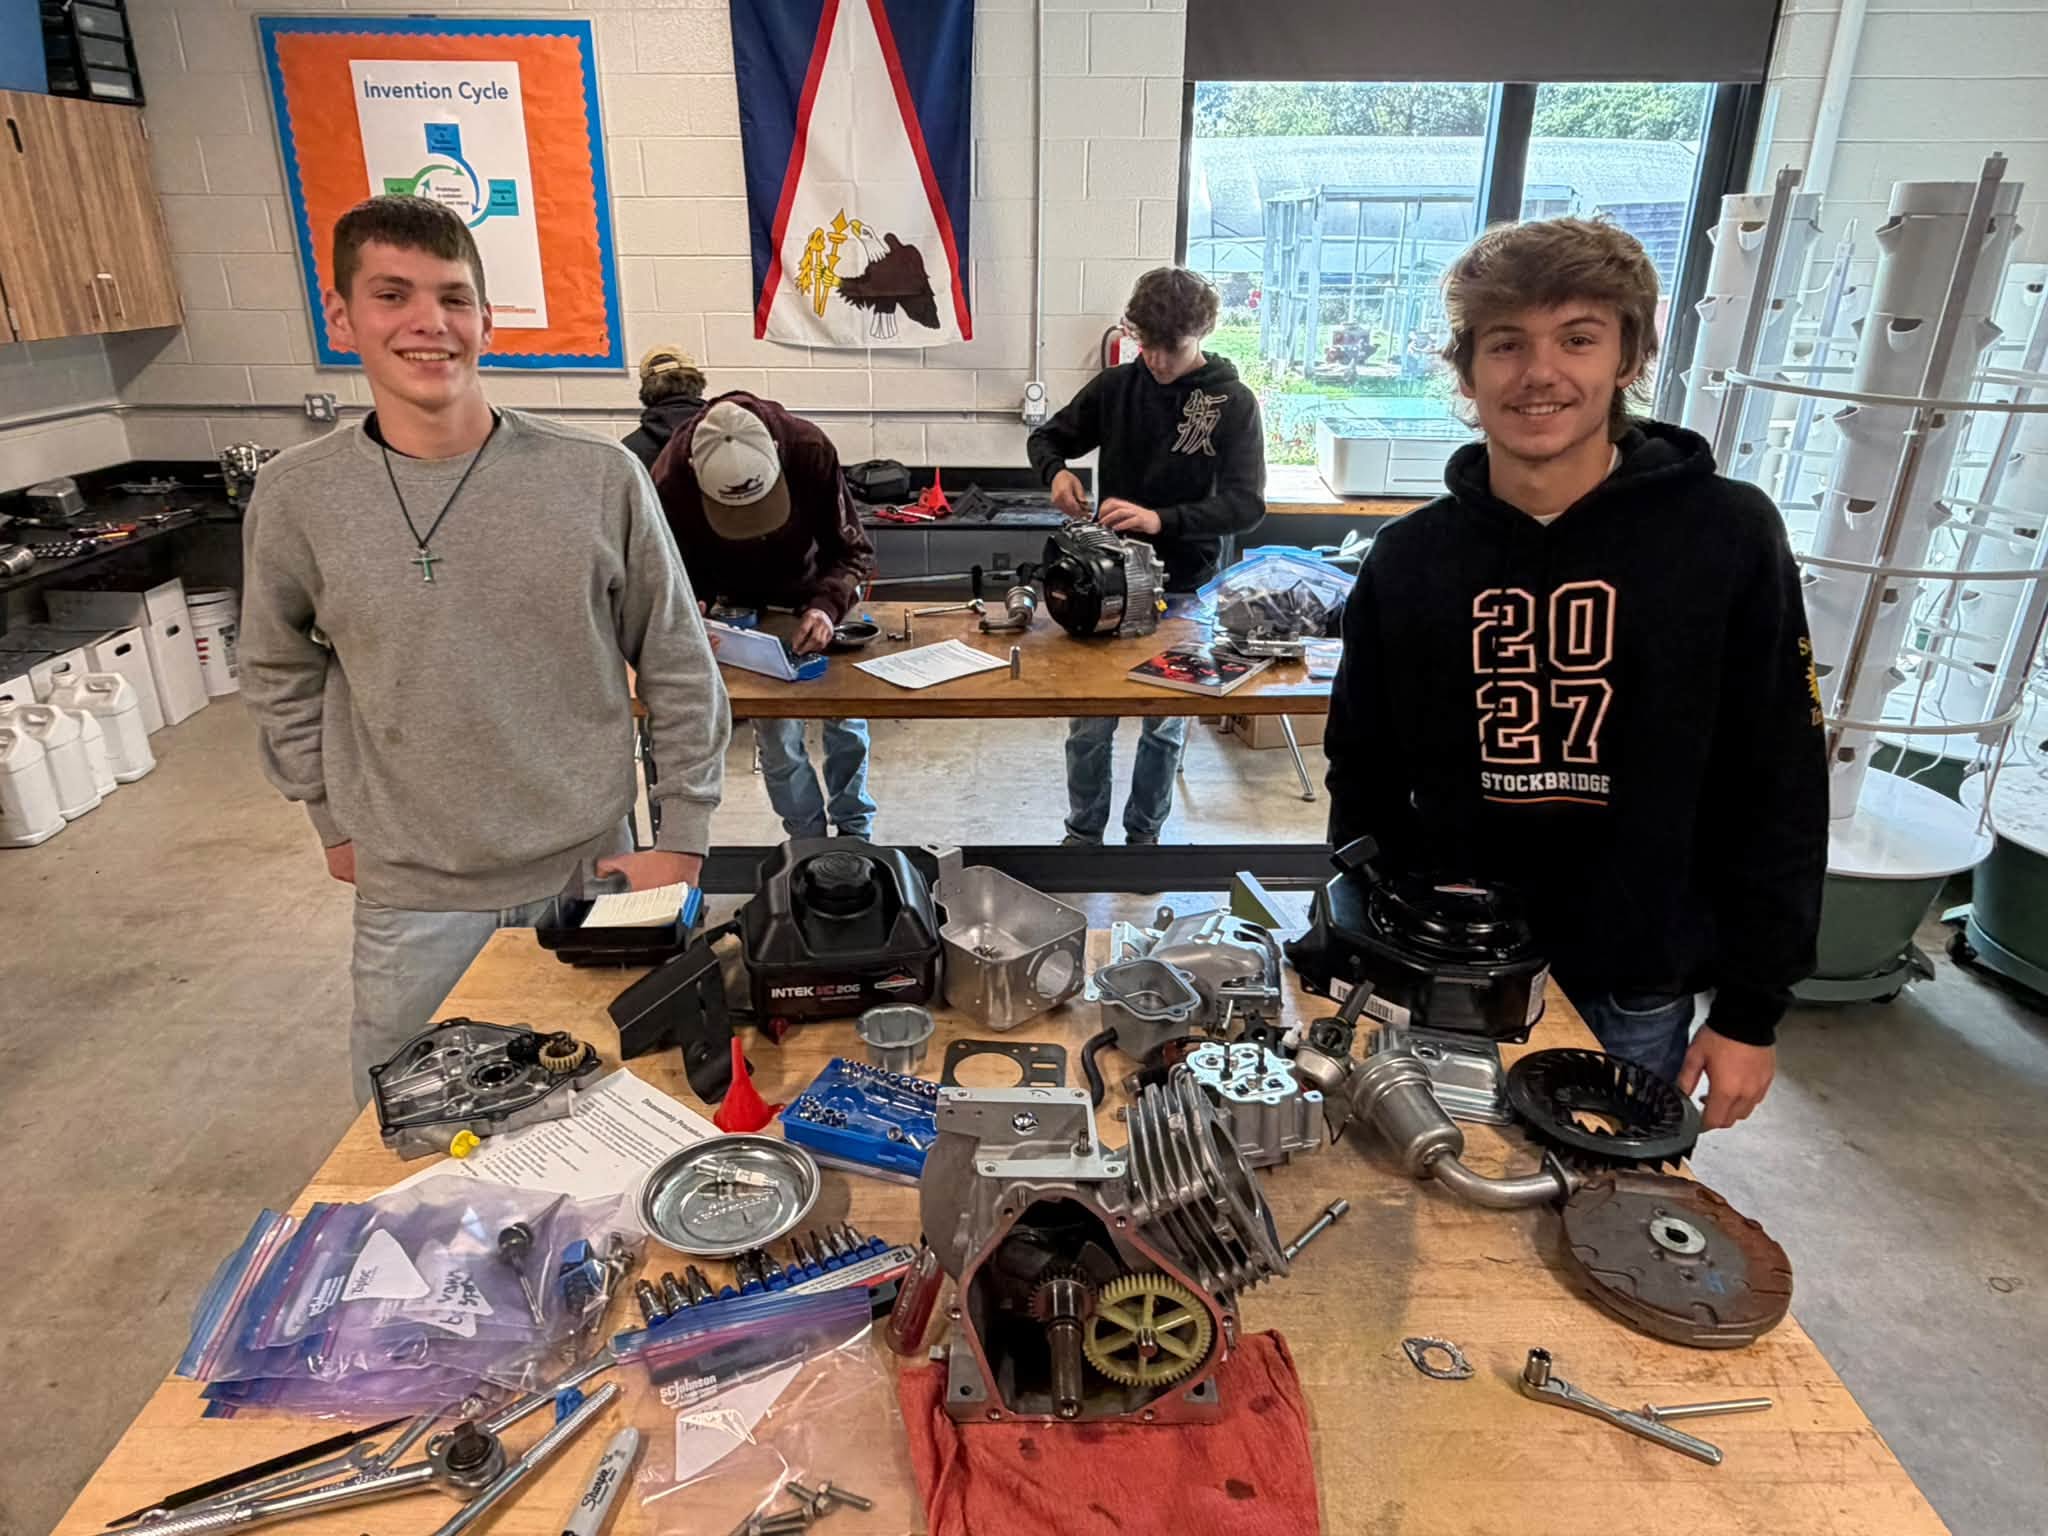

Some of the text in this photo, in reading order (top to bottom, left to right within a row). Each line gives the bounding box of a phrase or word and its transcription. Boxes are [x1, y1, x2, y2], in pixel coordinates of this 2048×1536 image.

[363, 80, 509, 104] Invention Cycle
[1472, 580, 1616, 673] 20
[1476, 678, 1614, 763] 27
[1481, 771, 1611, 794] STOCKBRIDGE
[770, 986, 814, 998] INTEK
[580, 1468, 611, 1513] Sharpie
